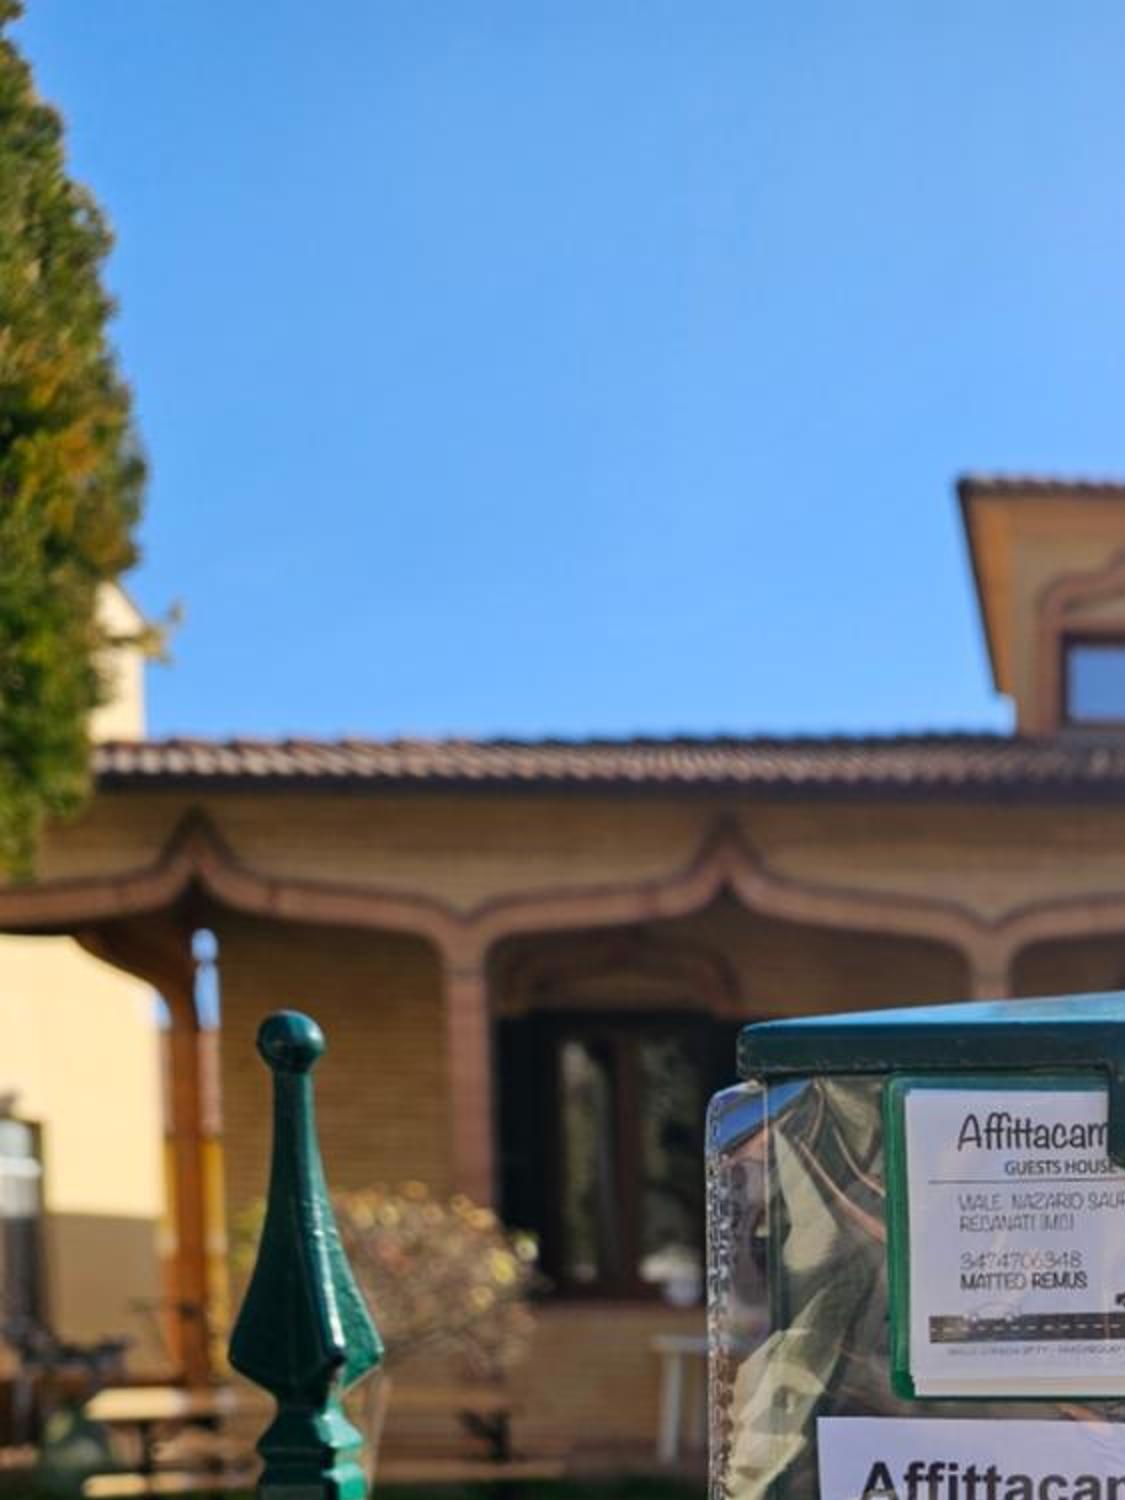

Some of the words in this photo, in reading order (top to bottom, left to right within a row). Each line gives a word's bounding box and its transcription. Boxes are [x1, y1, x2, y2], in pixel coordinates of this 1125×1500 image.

[1004, 1160, 1062, 1176] GUESTS
[960, 1272, 1027, 1291] MATTEO
[1031, 1270, 1089, 1289] REMUS
